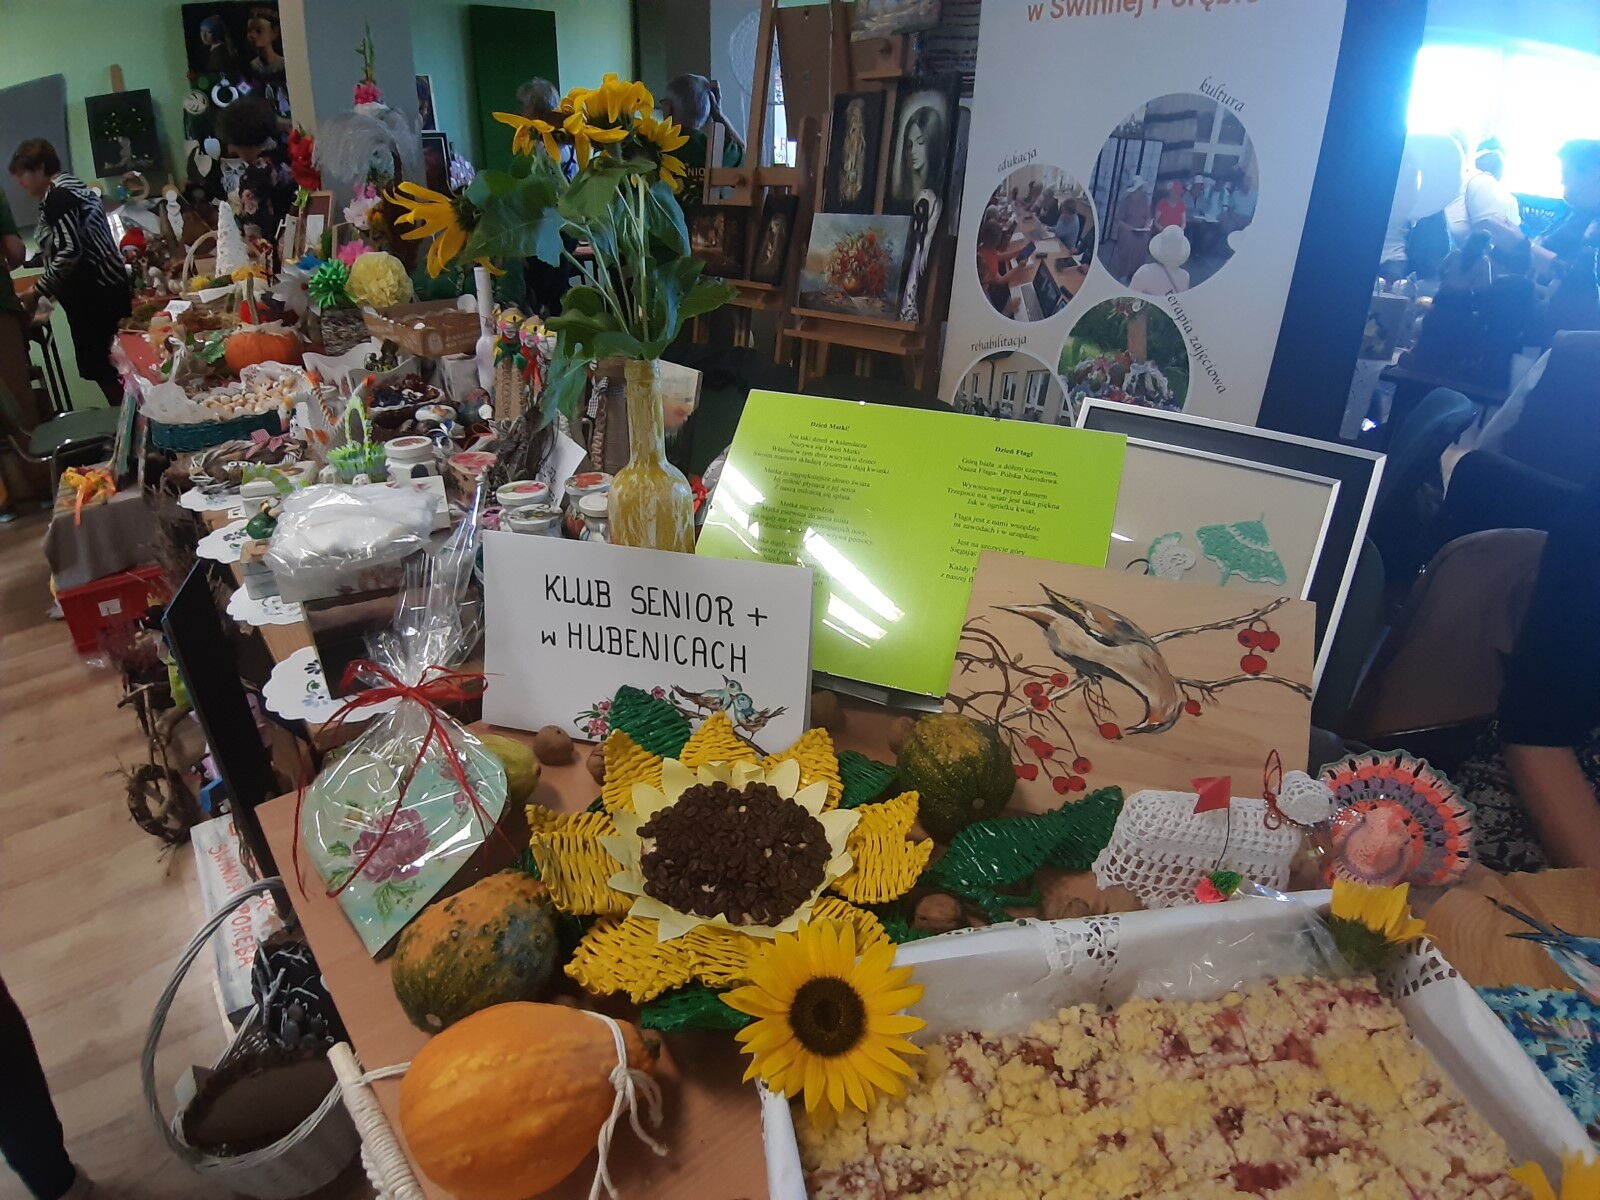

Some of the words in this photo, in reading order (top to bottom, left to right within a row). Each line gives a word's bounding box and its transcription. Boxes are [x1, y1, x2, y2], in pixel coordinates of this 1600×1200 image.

[1027, 4, 1043, 21] w
[1199, 76, 1245, 113] kultura
[997, 147, 1037, 172] edukacja
[971, 333, 1027, 352] rehabilitacja
[1165, 289, 1193, 334] terapia
[1190, 336, 1226, 394] zajęciowa
[810, 421, 827, 429] Dzień
[995, 446, 1014, 454] Dzień
[1016, 449, 1033, 457] Flagi
[1000, 471, 1021, 479] Polska
[1023, 490, 1047, 499] domem
[1037, 502, 1060, 510] piękna
[953, 513, 971, 521] Flaga
[1011, 523, 1040, 532] wszędzie
[963, 524, 995, 534] zawodach
[950, 546, 977, 556] Sięgając
[981, 544, 1009, 553] szczycie
[949, 563, 970, 573] Każdy
[946, 573, 967, 583] naszej
[545, 574, 611, 608] KLUB
[630, 585, 734, 627] SENIOR
[747, 608, 768, 627] +
[541, 630, 557, 646] w
[567, 621, 747, 673] HUBENICACH
[230, 903, 257, 968] PORĘBA
